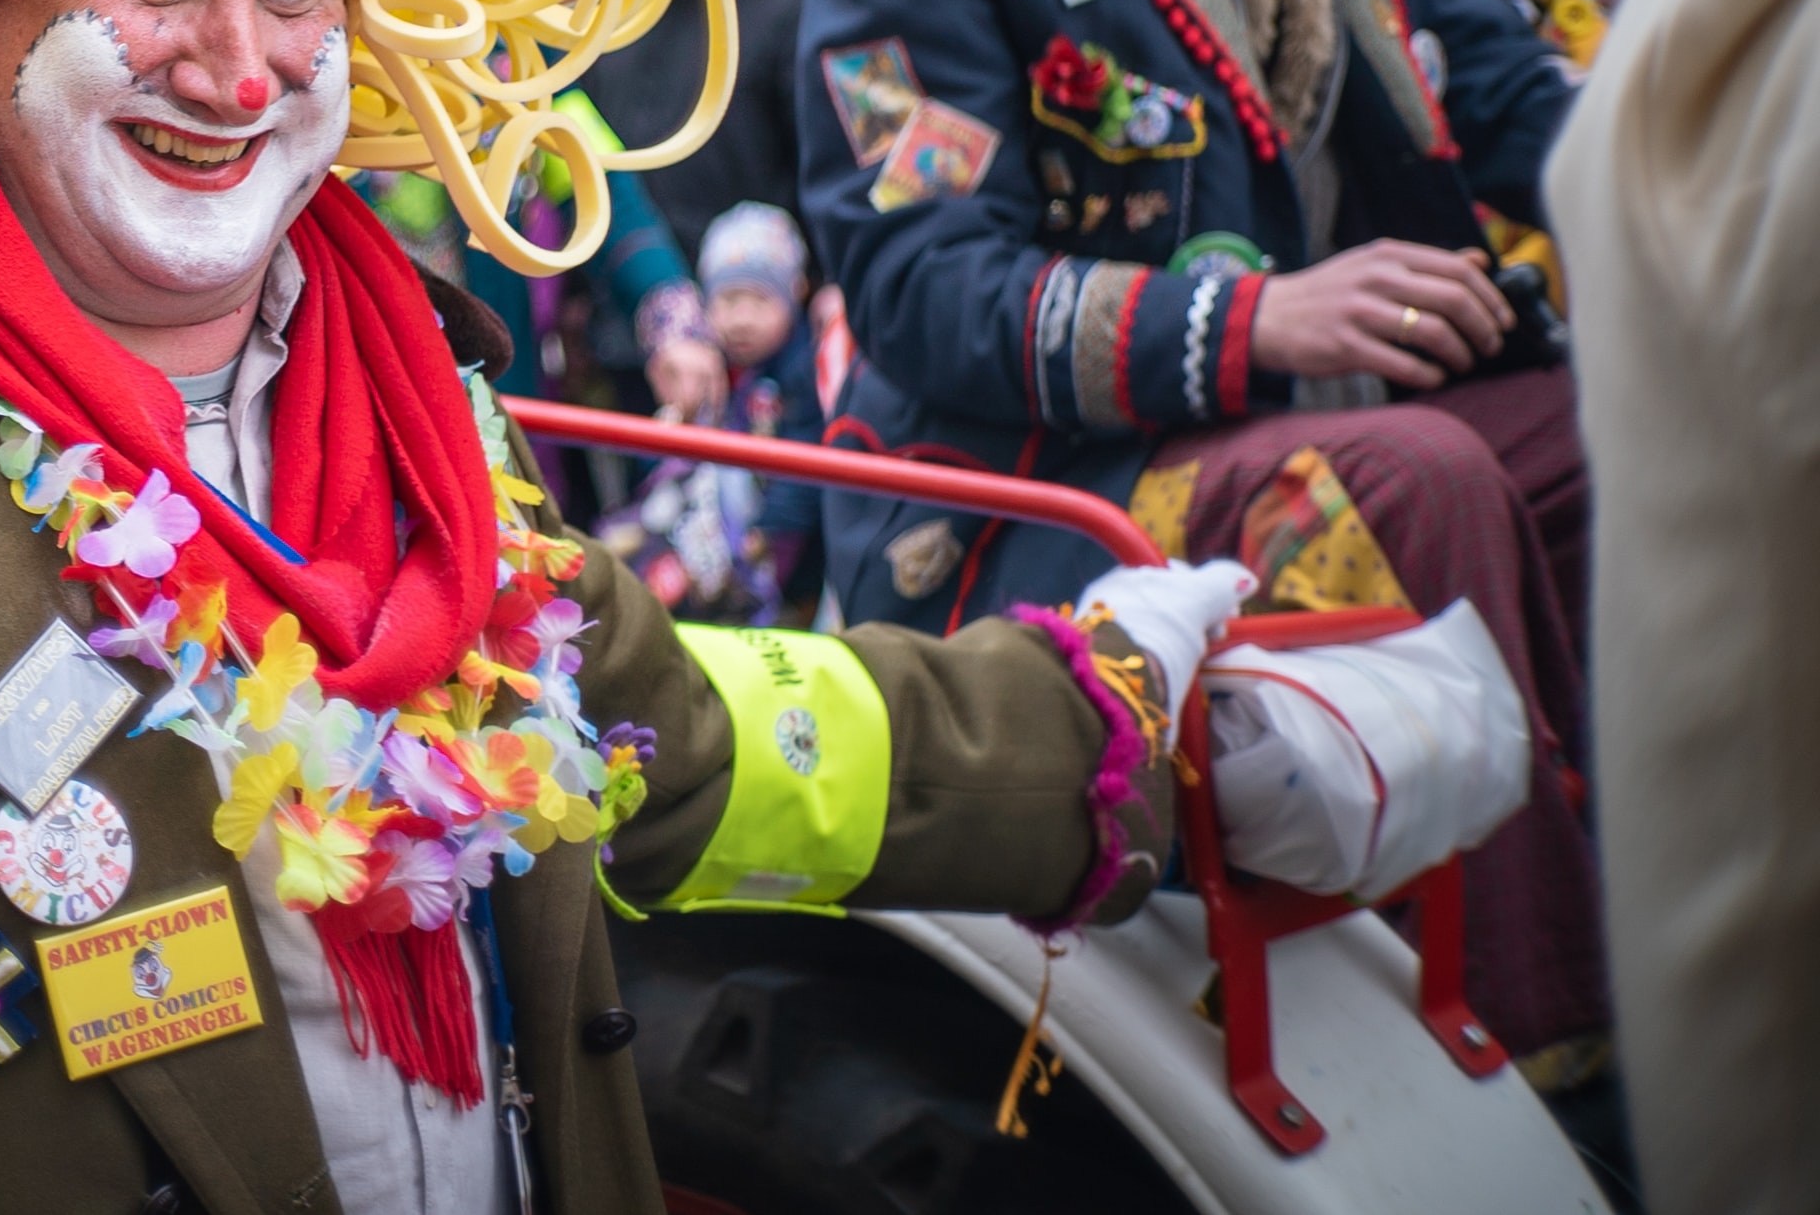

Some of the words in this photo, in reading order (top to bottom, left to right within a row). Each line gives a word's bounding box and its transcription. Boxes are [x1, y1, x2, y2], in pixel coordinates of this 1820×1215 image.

[21, 685, 138, 813] BARWALKER
[35, 700, 84, 757] LAST
[47, 898, 229, 970] SAFETY-CLOWN
[69, 1006, 149, 1045] CIRCUS
[153, 977, 248, 1019] COMICUS
[82, 1002, 248, 1068] WAGENENGEL
